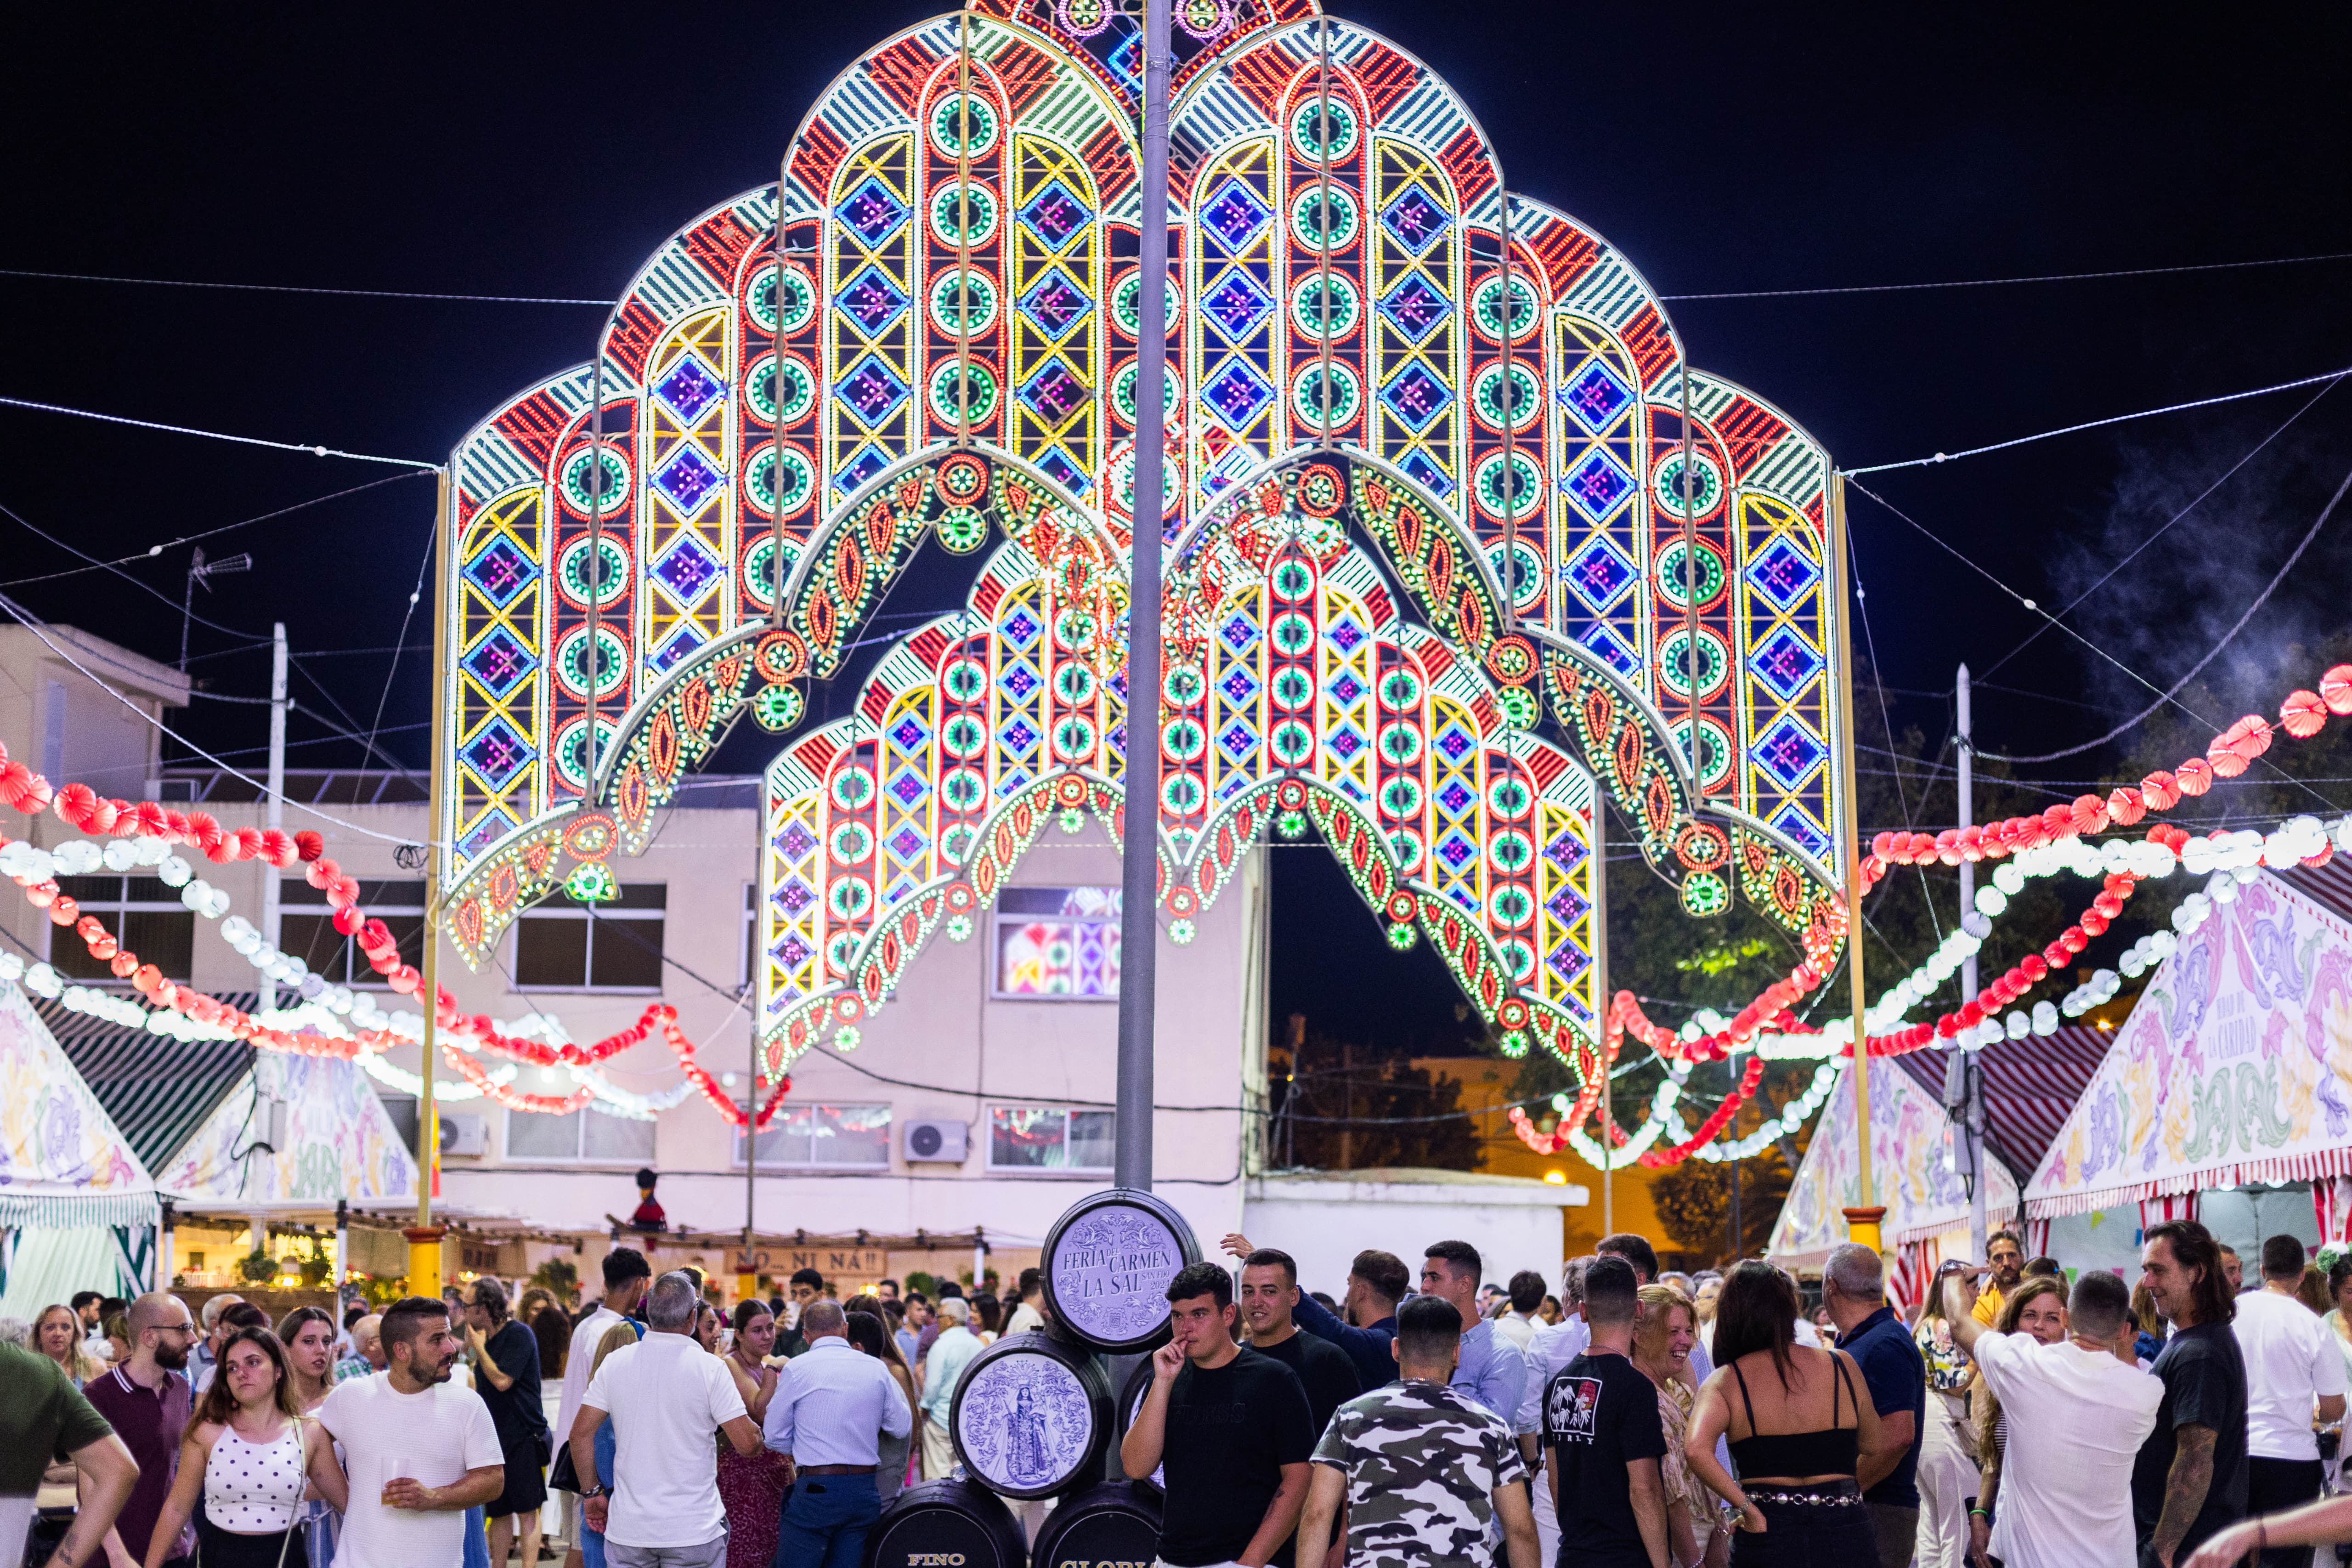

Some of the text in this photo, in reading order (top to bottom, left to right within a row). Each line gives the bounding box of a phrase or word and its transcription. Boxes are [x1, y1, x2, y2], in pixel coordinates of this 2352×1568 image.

[1063, 1248, 1172, 1274] FERIA DEL CARMEN
[1142, 1270, 1170, 1281] SAN FDO
[1077, 1271, 1142, 1298] Y LA SAL
[1150, 1279, 1170, 1290] 2024
[908, 1553, 965, 1566] FINO
